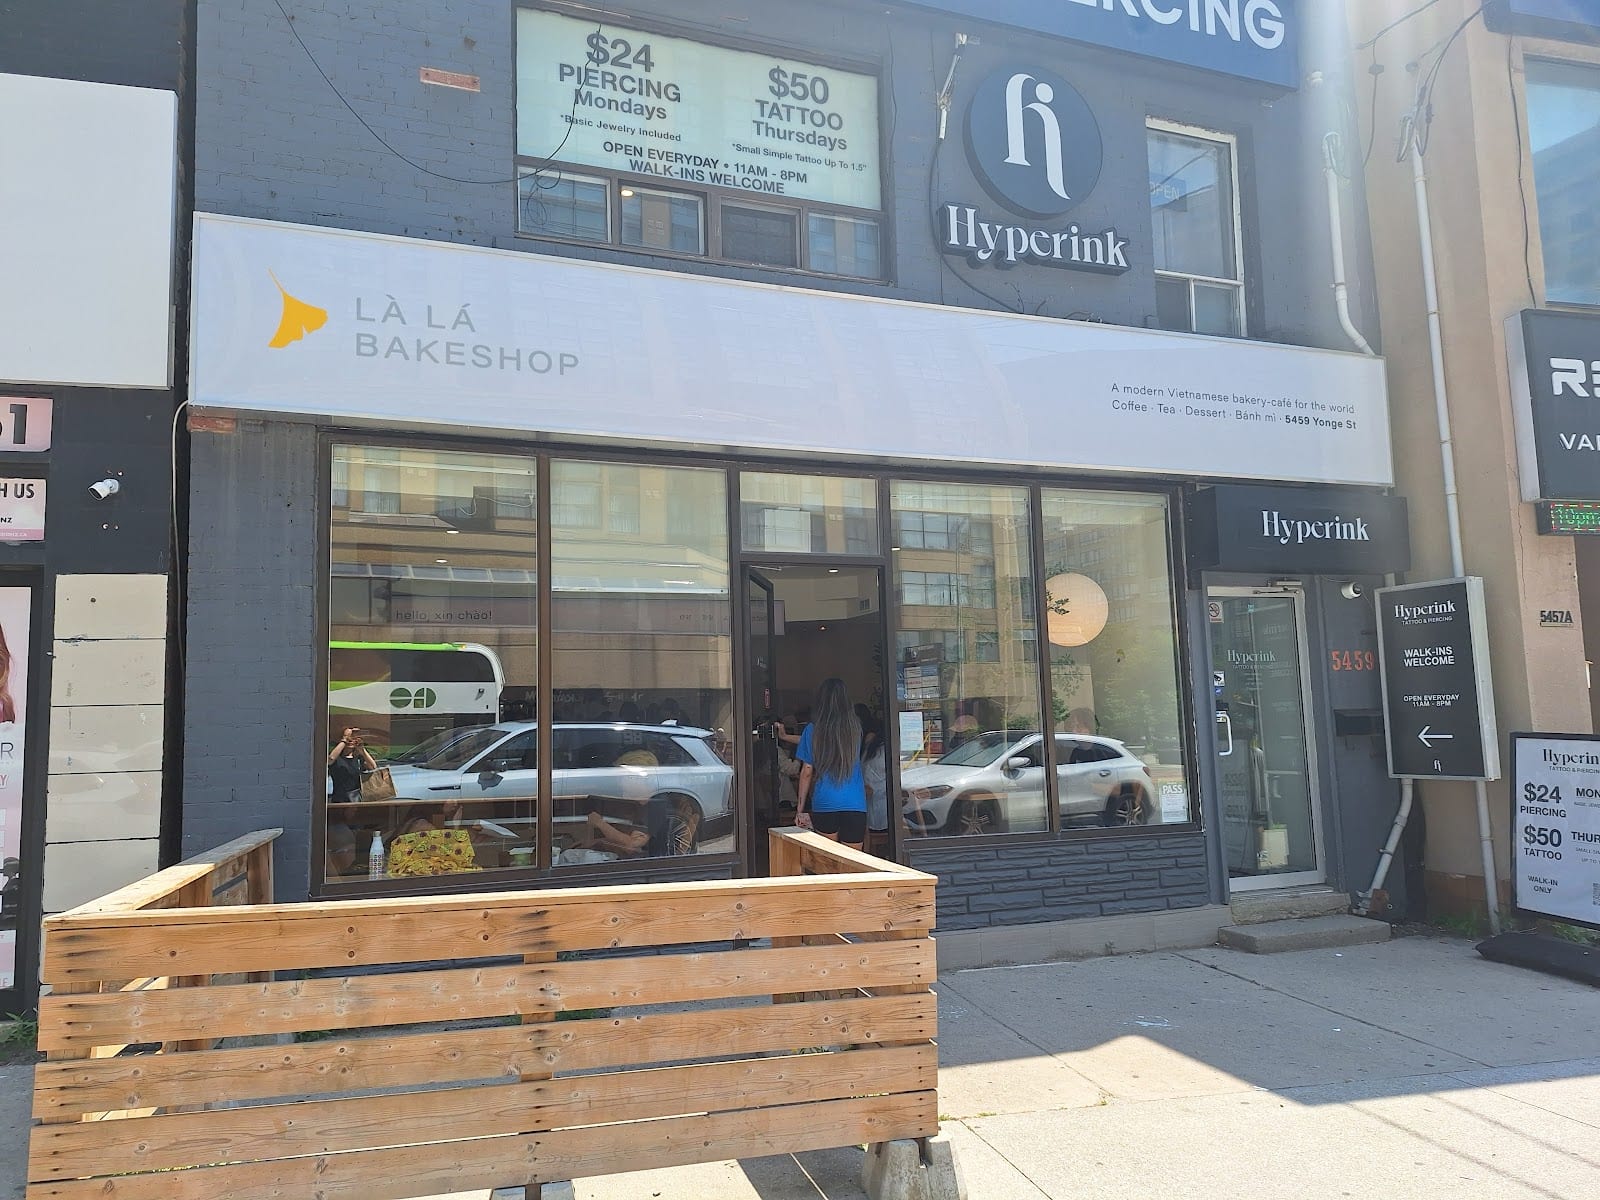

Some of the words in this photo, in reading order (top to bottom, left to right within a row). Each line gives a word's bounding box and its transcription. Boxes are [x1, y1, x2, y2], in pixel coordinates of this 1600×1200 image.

[586, 30, 654, 73] $24
[559, 63, 681, 103] PIERCING
[768, 65, 829, 105] $50
[574, 88, 667, 121] Mondays
[755, 100, 843, 131] TATTOO
[596, 120, 636, 136] Jewelry
[638, 125, 682, 142] Included
[752, 120, 848, 151] Thursdays
[602, 140, 643, 157] OPEN
[647, 147, 719, 170] EVERYDAY
[734, 162, 768, 178] 11AM
[780, 169, 808, 184] 8PM
[763, 147, 793, 162] Simple
[795, 151, 822, 166] Tattoo
[824, 156, 837, 169] Up
[838, 159, 849, 170] To
[629, 158, 705, 182] WALK-INS
[709, 172, 785, 194] WELCOME
[946, 203, 1129, 268] Hyperink
[355, 294, 408, 326] LÀ
[427, 303, 476, 333] LÁ
[355, 332, 579, 376] BAKESHOP
[1550, 357, 1600, 398] R
[1111, 383, 1120, 393] A
[1123, 385, 1164, 397] modern
[1167, 387, 1229, 402] Vietnamese
[1232, 393, 1292, 408] bakery-café
[1294, 398, 1308, 410] for
[1311, 400, 1327, 412] the
[1329, 403, 1355, 414] world
[1112, 399, 1148, 412] Coffee
[1157, 403, 1176, 415] Tea
[1185, 405, 1226, 419] Dessert
[1235, 409, 1261, 422] Bánh
[1285, 414, 1310, 425] 5459
[1313, 416, 1343, 430] Yonge
[1346, 419, 1357, 430] St
[1559, 433, 1600, 451] VA
[14, 483, 35, 499] US
[1262, 510, 1370, 544] Hyperink
[1394, 600, 1456, 620] Hyperink
[1540, 610, 1573, 624] 5457A
[1227, 649, 1276, 664] Hyperink
[1331, 650, 1374, 671] 5459
[1404, 647, 1453, 657] WALK-INS
[1404, 656, 1455, 667] WELCOME
[1542, 748, 1600, 766] Hyperin
[1162, 784, 1183, 794] PASS
[1524, 781, 1562, 804] $24
[1520, 806, 1567, 818] PIERCING
[1524, 824, 1562, 848] $50
[1524, 848, 1562, 860] TATTOO
[1528, 875, 1558, 886] WALK-IN
[1533, 886, 1552, 894] ONLY
